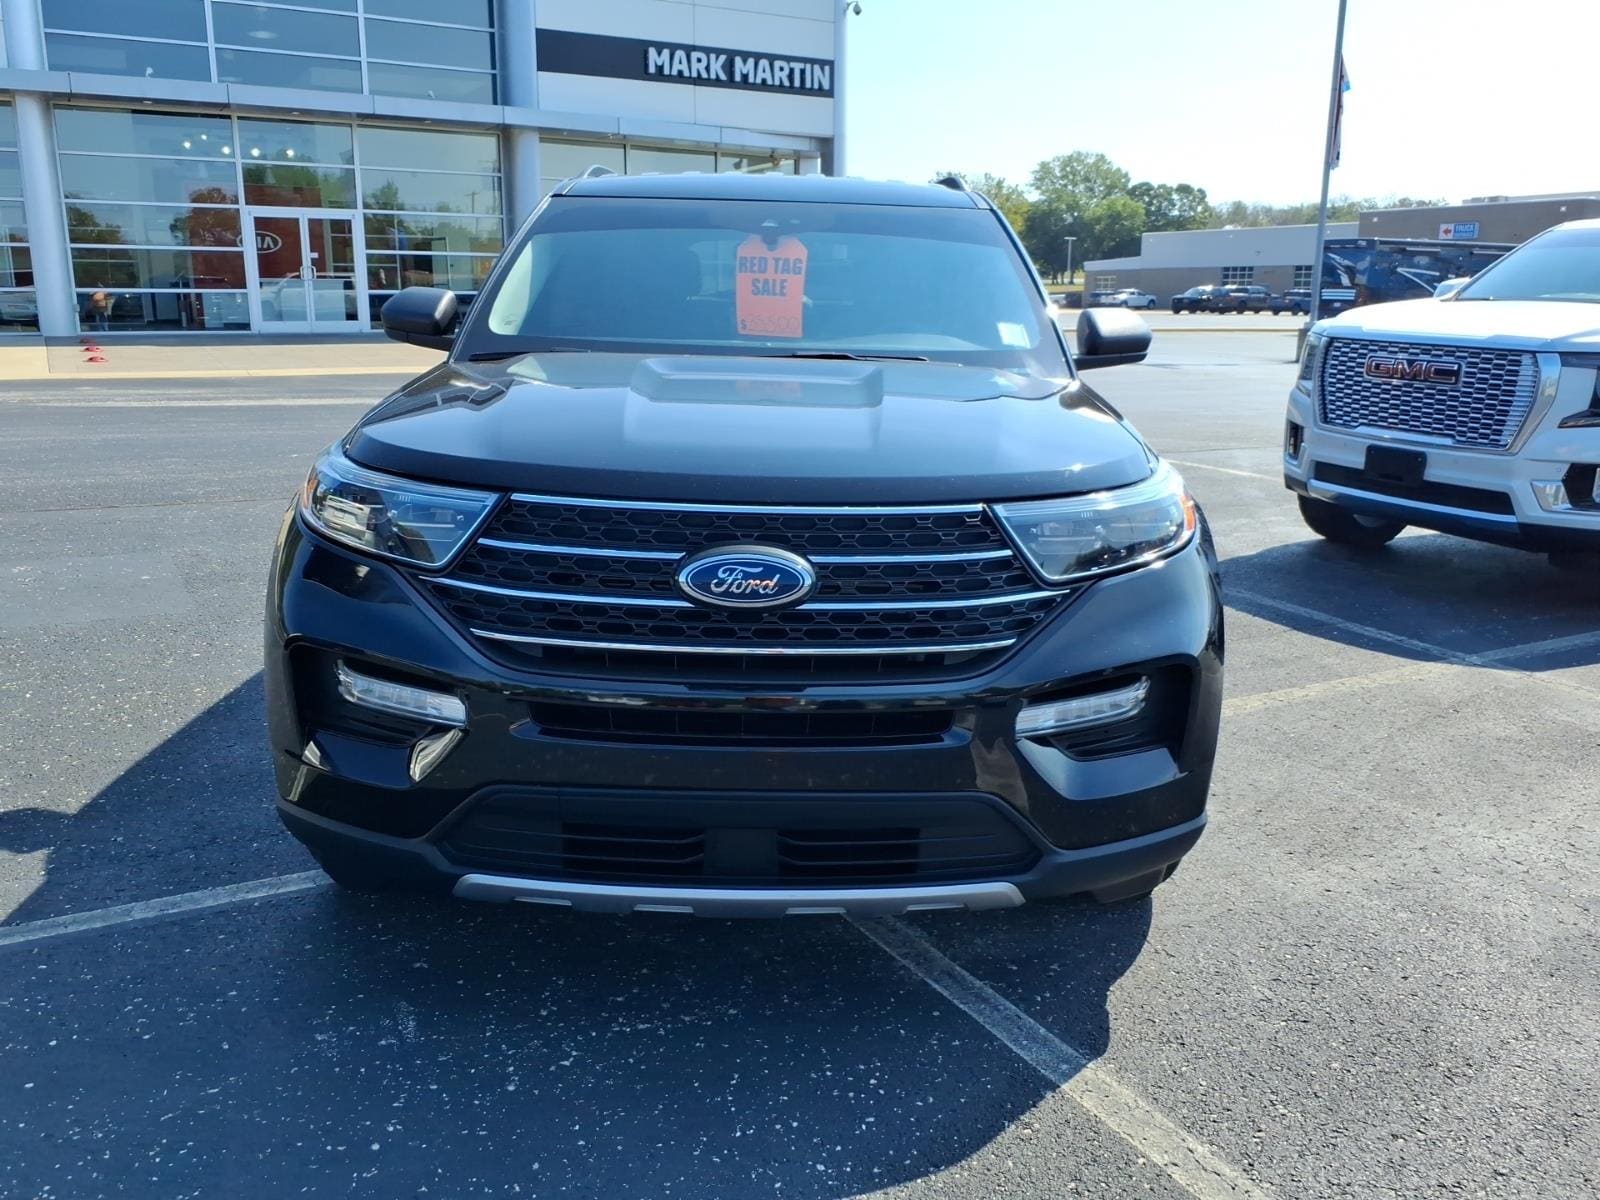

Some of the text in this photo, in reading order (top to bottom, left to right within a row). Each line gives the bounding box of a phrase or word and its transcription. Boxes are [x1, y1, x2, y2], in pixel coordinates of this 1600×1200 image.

[647, 46, 831, 91] MARK MARTIN
[738, 256, 803, 275] RED TAG
[751, 278, 788, 296] SALE
[1365, 357, 1459, 384] GMC
[710, 565, 781, 594] Ford
